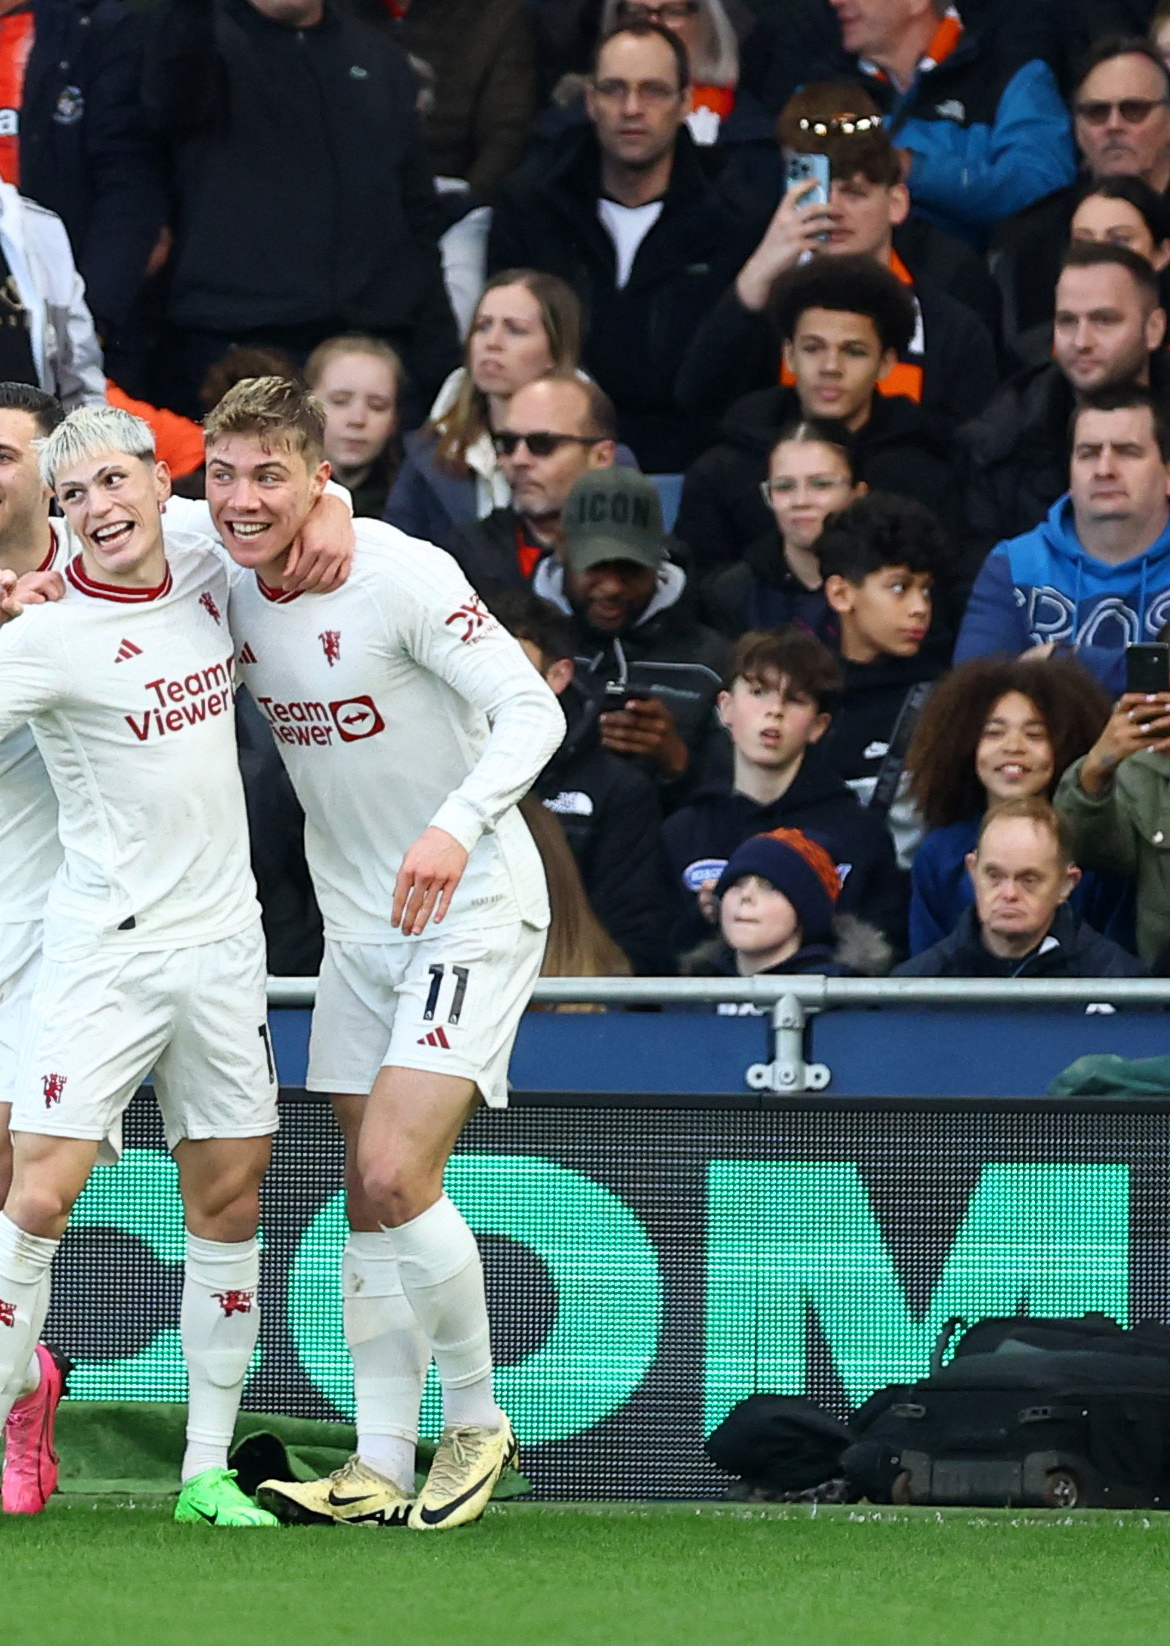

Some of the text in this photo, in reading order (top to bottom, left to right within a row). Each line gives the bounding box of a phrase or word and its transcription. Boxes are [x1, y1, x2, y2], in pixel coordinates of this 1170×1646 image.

[145, 662, 228, 708] Team
[124, 687, 230, 742] Viewer
[257, 697, 330, 725] Team
[272, 724, 333, 746] iewer
[423, 963, 470, 1026] 11
